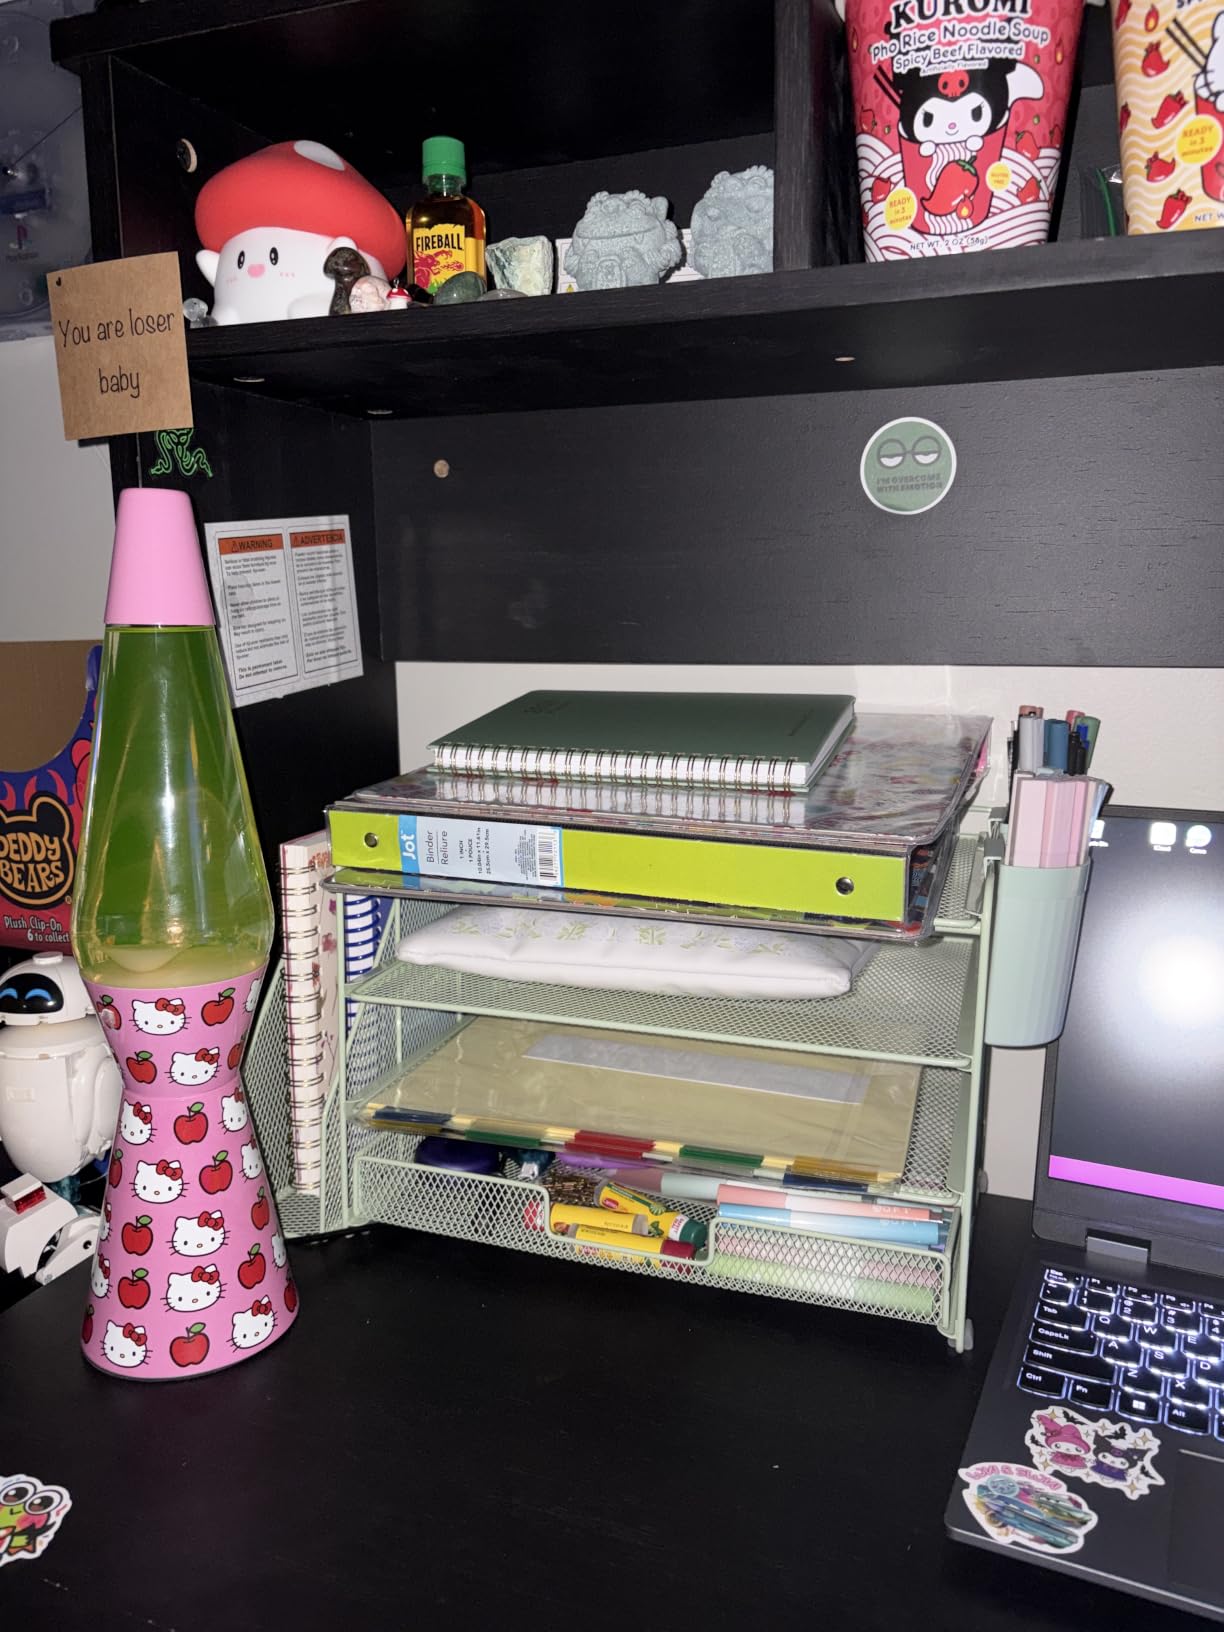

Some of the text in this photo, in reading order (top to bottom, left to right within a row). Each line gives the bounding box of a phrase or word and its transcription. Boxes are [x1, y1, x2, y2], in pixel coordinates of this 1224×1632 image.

[871, 21, 1049, 60] Pho Rice Noodle Soup
[895, 43, 1023, 70] Spicy Beef Flavored
[1182, 125, 1214, 137] READY
[889, 197, 911, 208] READY
[889, 215, 912, 225] minutes
[1194, 212, 1212, 222] NET
[416, 233, 463, 251] FIREBALL
[910, 242, 925, 251] NET
[945, 239, 950, 247] 2
[952, 238, 964, 246] OZ
[58, 308, 175, 348] You are loser
[98, 365, 141, 398] baby
[239, 539, 273, 550] WARNING
[300, 533, 344, 545] ADVERTENCIA
[400, 833, 417, 860] Jot
[425, 830, 435, 863] Binder
[440, 830, 449, 865] Reliure
[0, 859, 65, 893] BEARS
[4, 916, 62, 932] Plush Clip-On
[27, 929, 70, 943] 6 to collect
[1043, 1305, 1058, 1314] Tab
[1099, 1315, 1111, 1324] Q
[1038, 1328, 1069, 1340] CapsLk
[1143, 1326, 1157, 1335] W
[1108, 1340, 1119, 1349] A
[1187, 1336, 1197, 1344] E
[1033, 1349, 1053, 1359] Shift
[1154, 1351, 1164, 1360] S
[1200, 1361, 1211, 1370] D
[1026, 1372, 1042, 1381] Ctrl
[1128, 1368, 1138, 1378] Z
[1076, 1384, 1088, 1393] Fn
[1175, 1379, 1186, 1390] X
[1172, 1409, 1186, 1418] Alt
